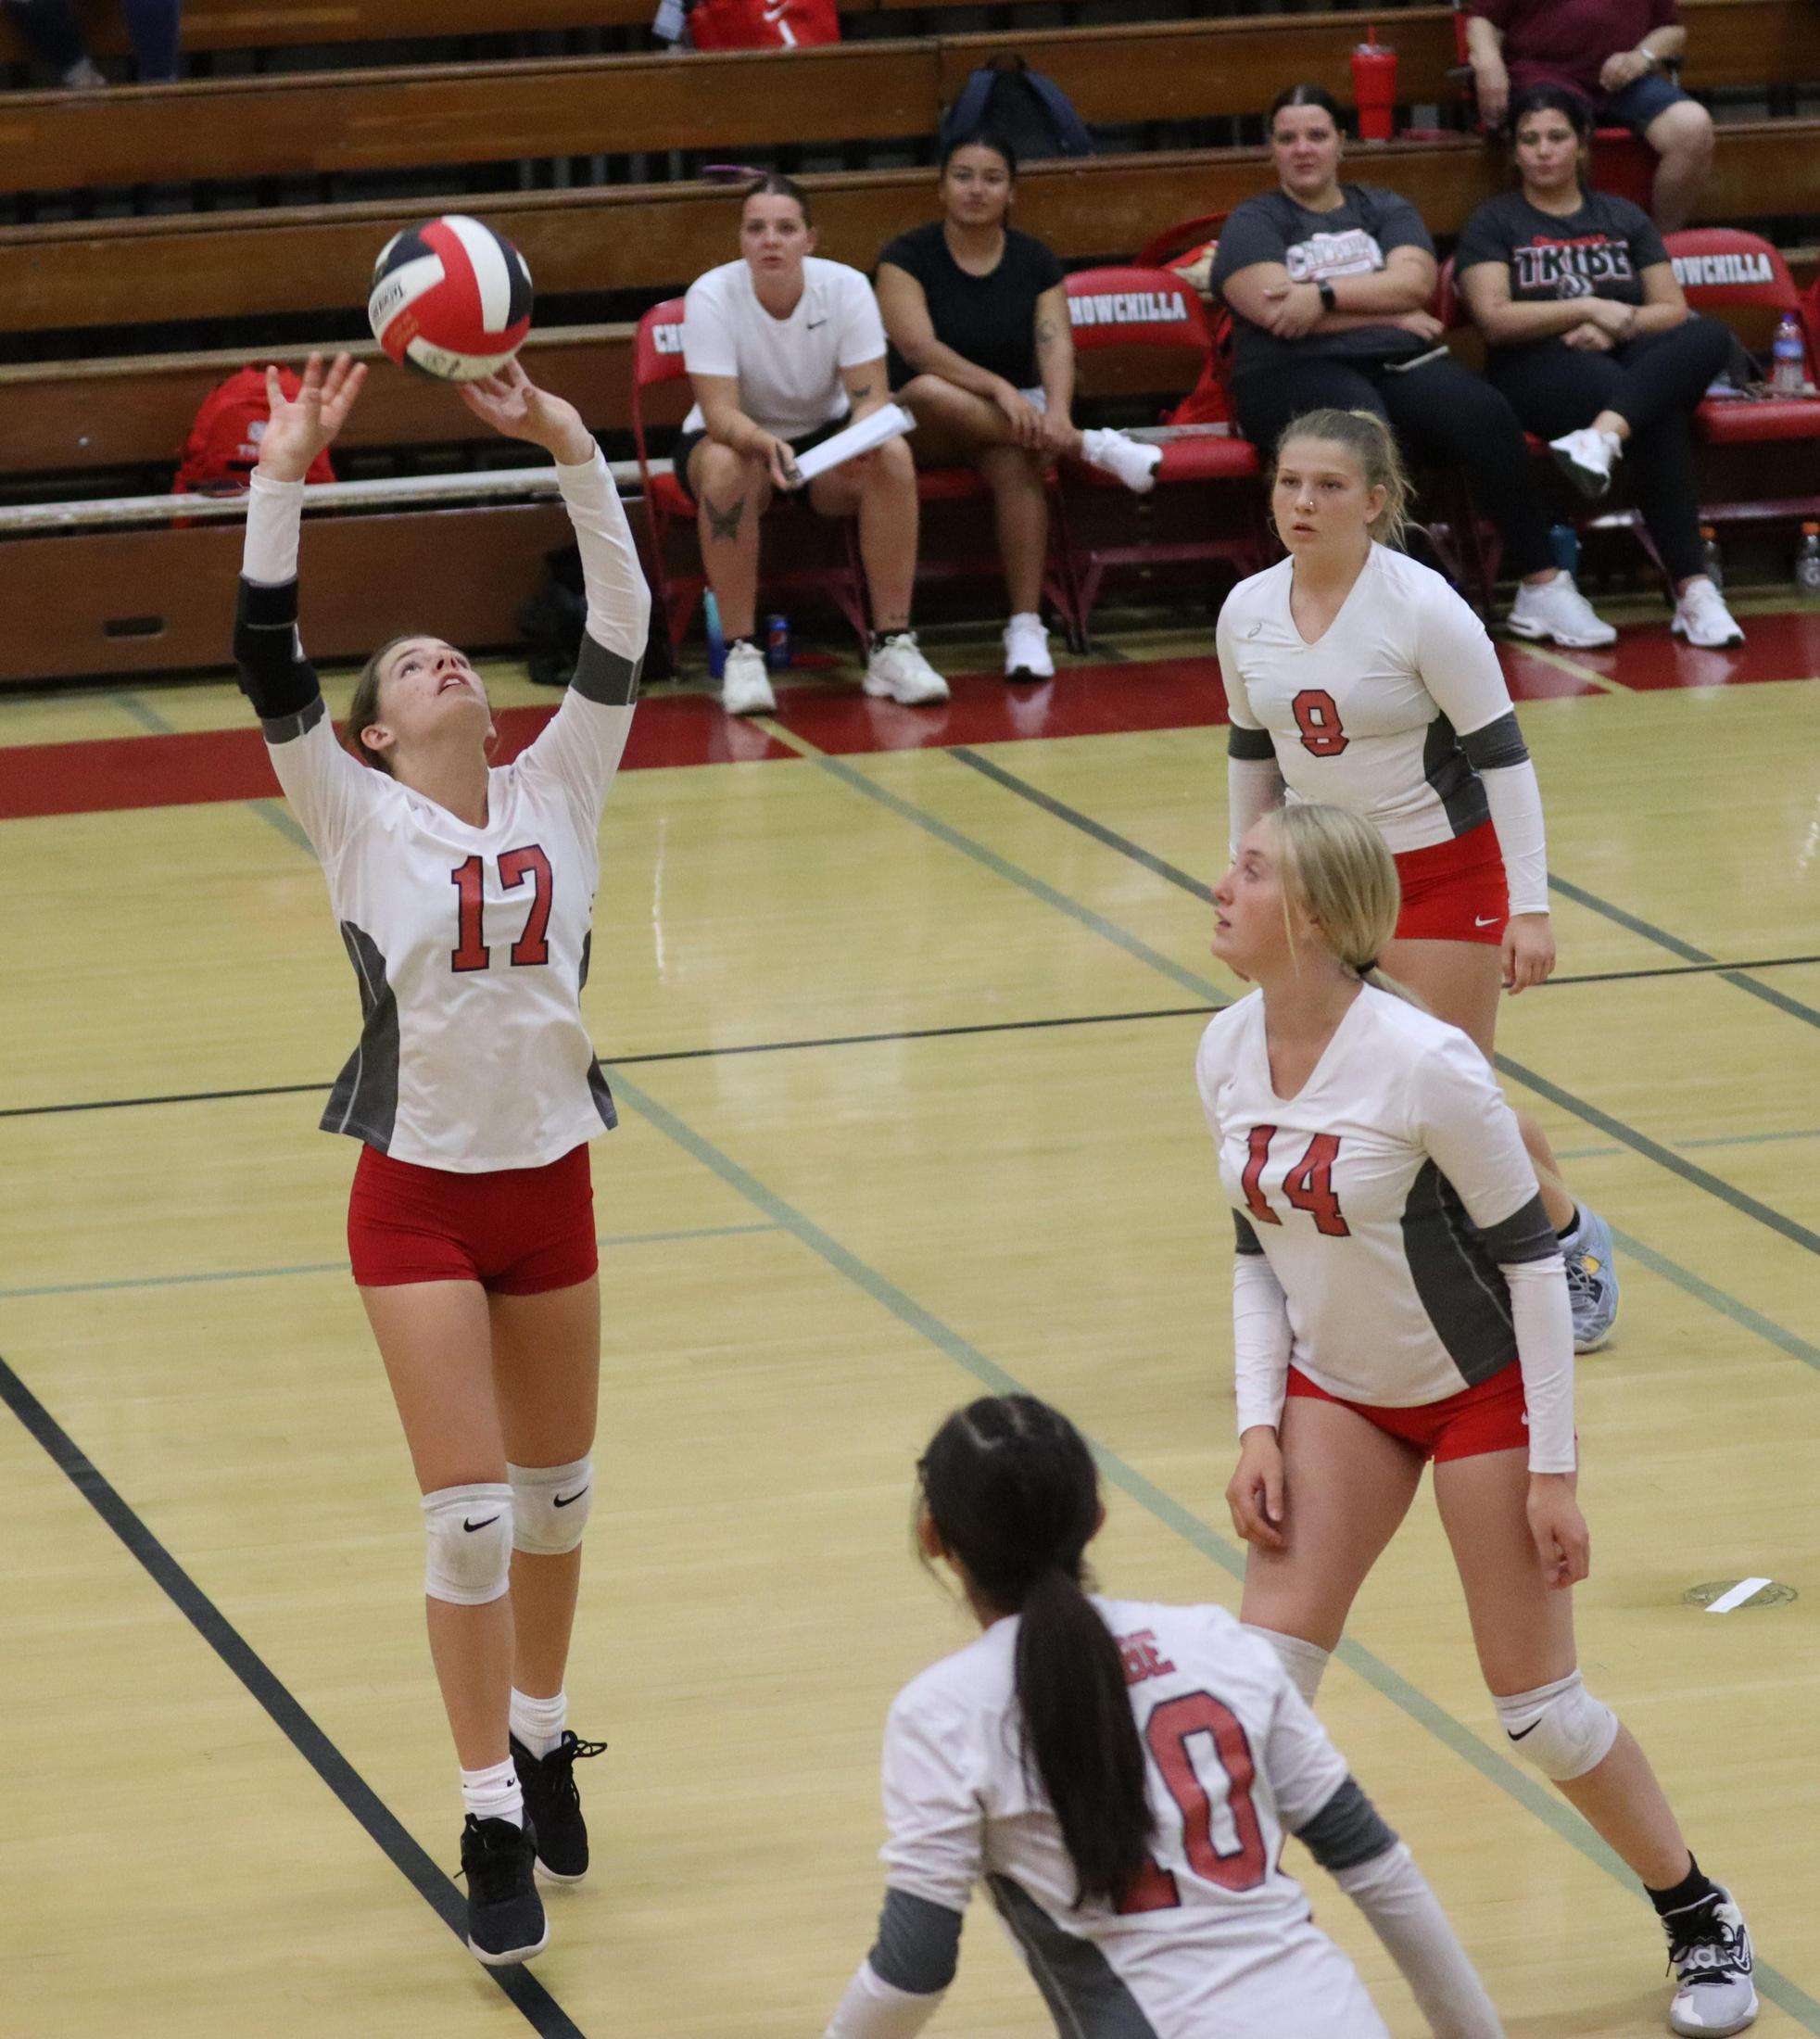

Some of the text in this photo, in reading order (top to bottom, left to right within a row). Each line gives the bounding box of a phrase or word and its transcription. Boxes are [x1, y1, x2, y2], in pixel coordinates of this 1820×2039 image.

[1513, 240, 1631, 288] TRIBE
[1671, 253, 1775, 287] OWCHILLA
[1068, 291, 1187, 325] HOWCHILLA
[451, 843, 553, 973] 17
[1241, 1124, 1351, 1237] 14
